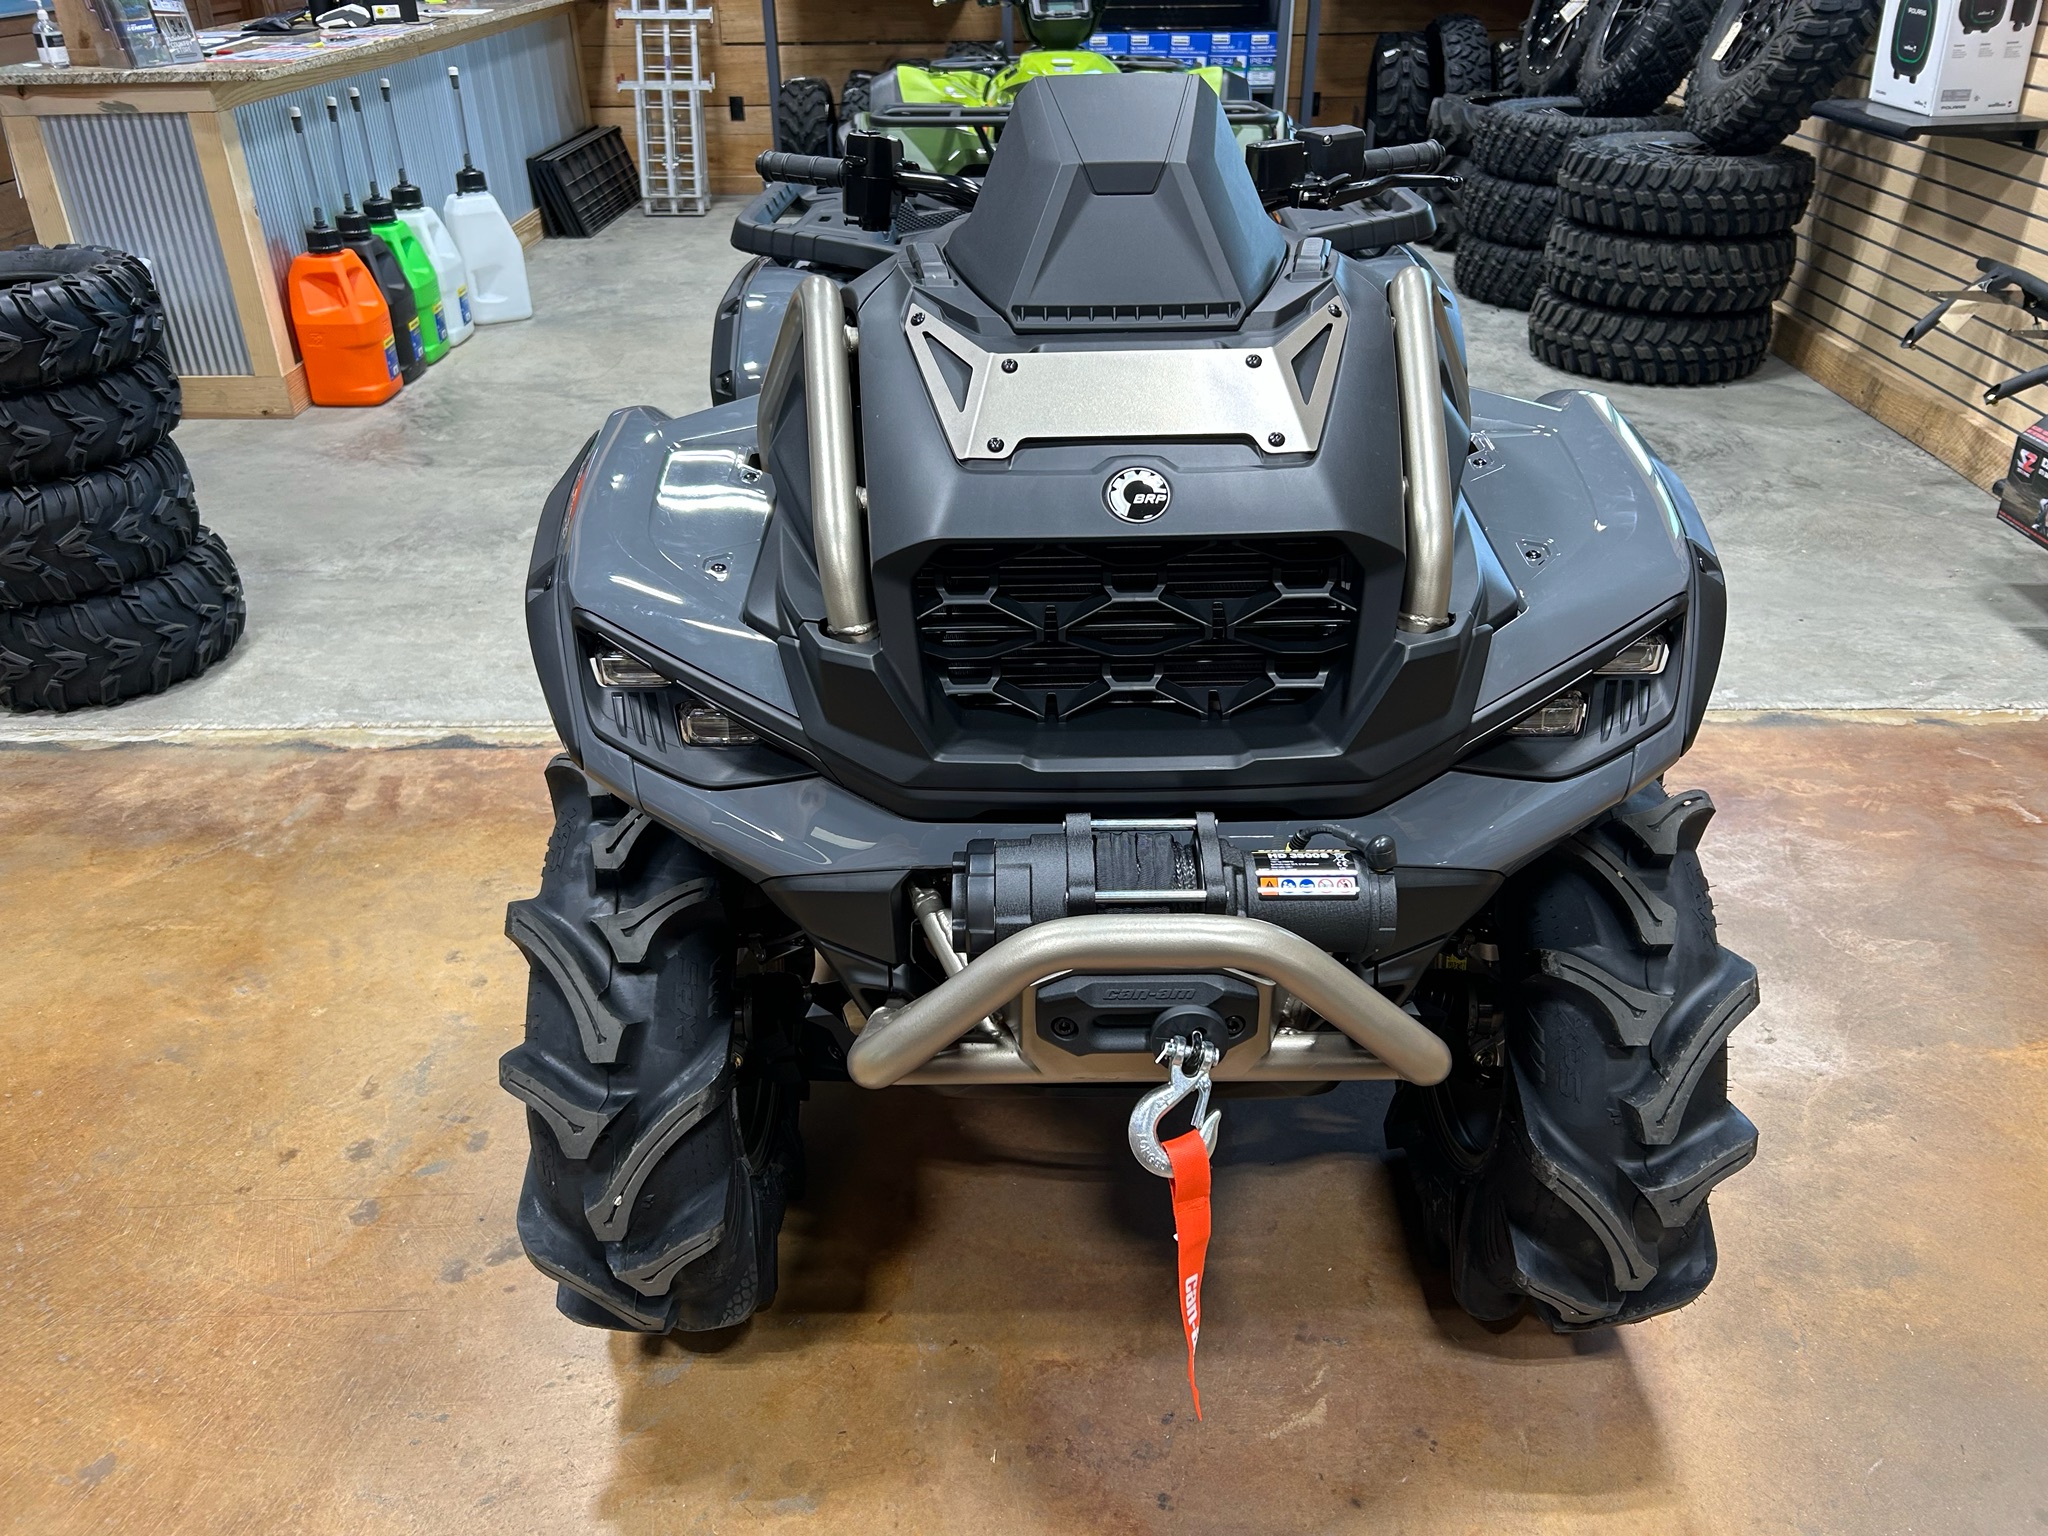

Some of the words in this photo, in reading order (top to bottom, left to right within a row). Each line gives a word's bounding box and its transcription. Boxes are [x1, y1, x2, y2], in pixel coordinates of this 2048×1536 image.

[1908, 7, 1927, 17] POLARIS
[1133, 494, 1167, 504] BRP
[1102, 987, 1197, 1001] can-am
[1185, 1272, 1200, 1358] can-a
